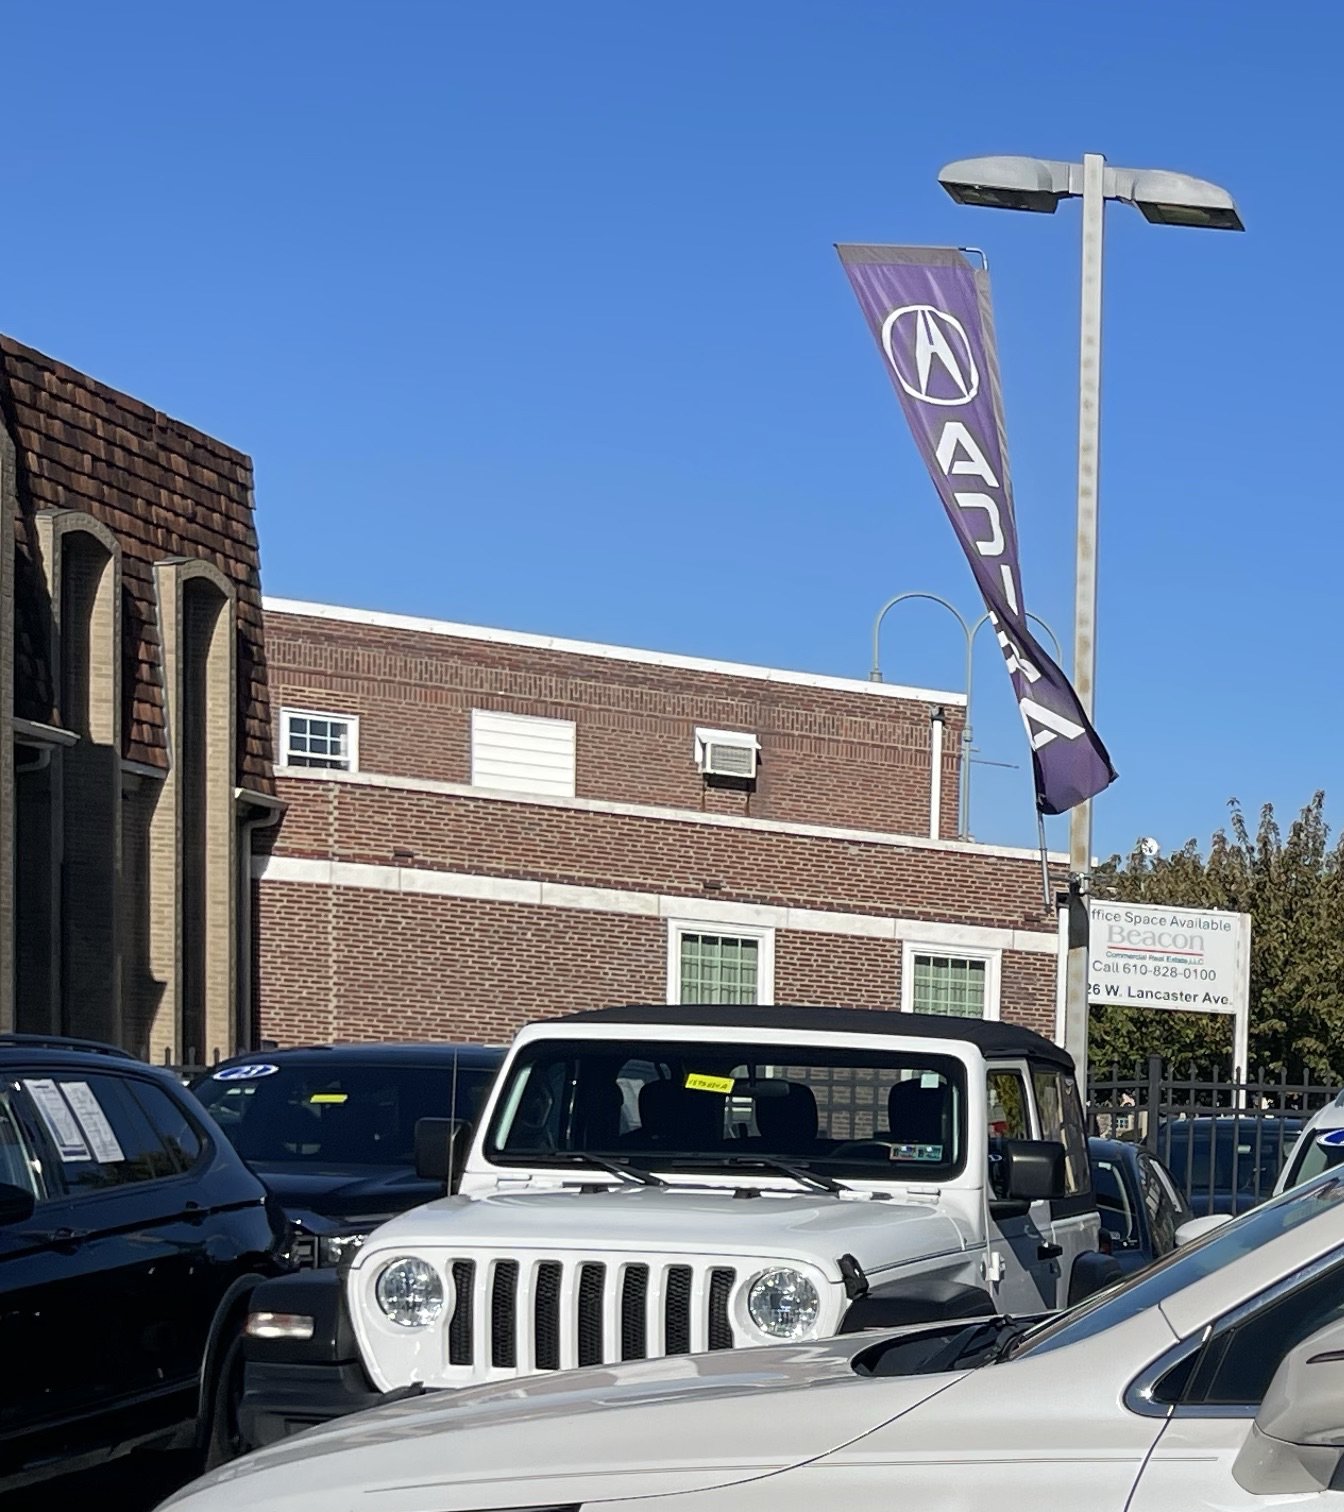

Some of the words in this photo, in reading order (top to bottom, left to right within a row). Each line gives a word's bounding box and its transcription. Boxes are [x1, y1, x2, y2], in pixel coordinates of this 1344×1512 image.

[1090, 908, 1121, 922] ffice
[1124, 911, 1167, 926] Space
[1169, 915, 1232, 932] Available
[1107, 924, 1205, 951] Beacon
[1105, 950, 1147, 961] Commercial
[1092, 960, 1119, 973] Call
[1122, 963, 1217, 981] 610-828-0100
[1104, 984, 1123, 997] W.
[1127, 985, 1199, 1003] Lancaster
[1202, 991, 1233, 1005] Ave.
